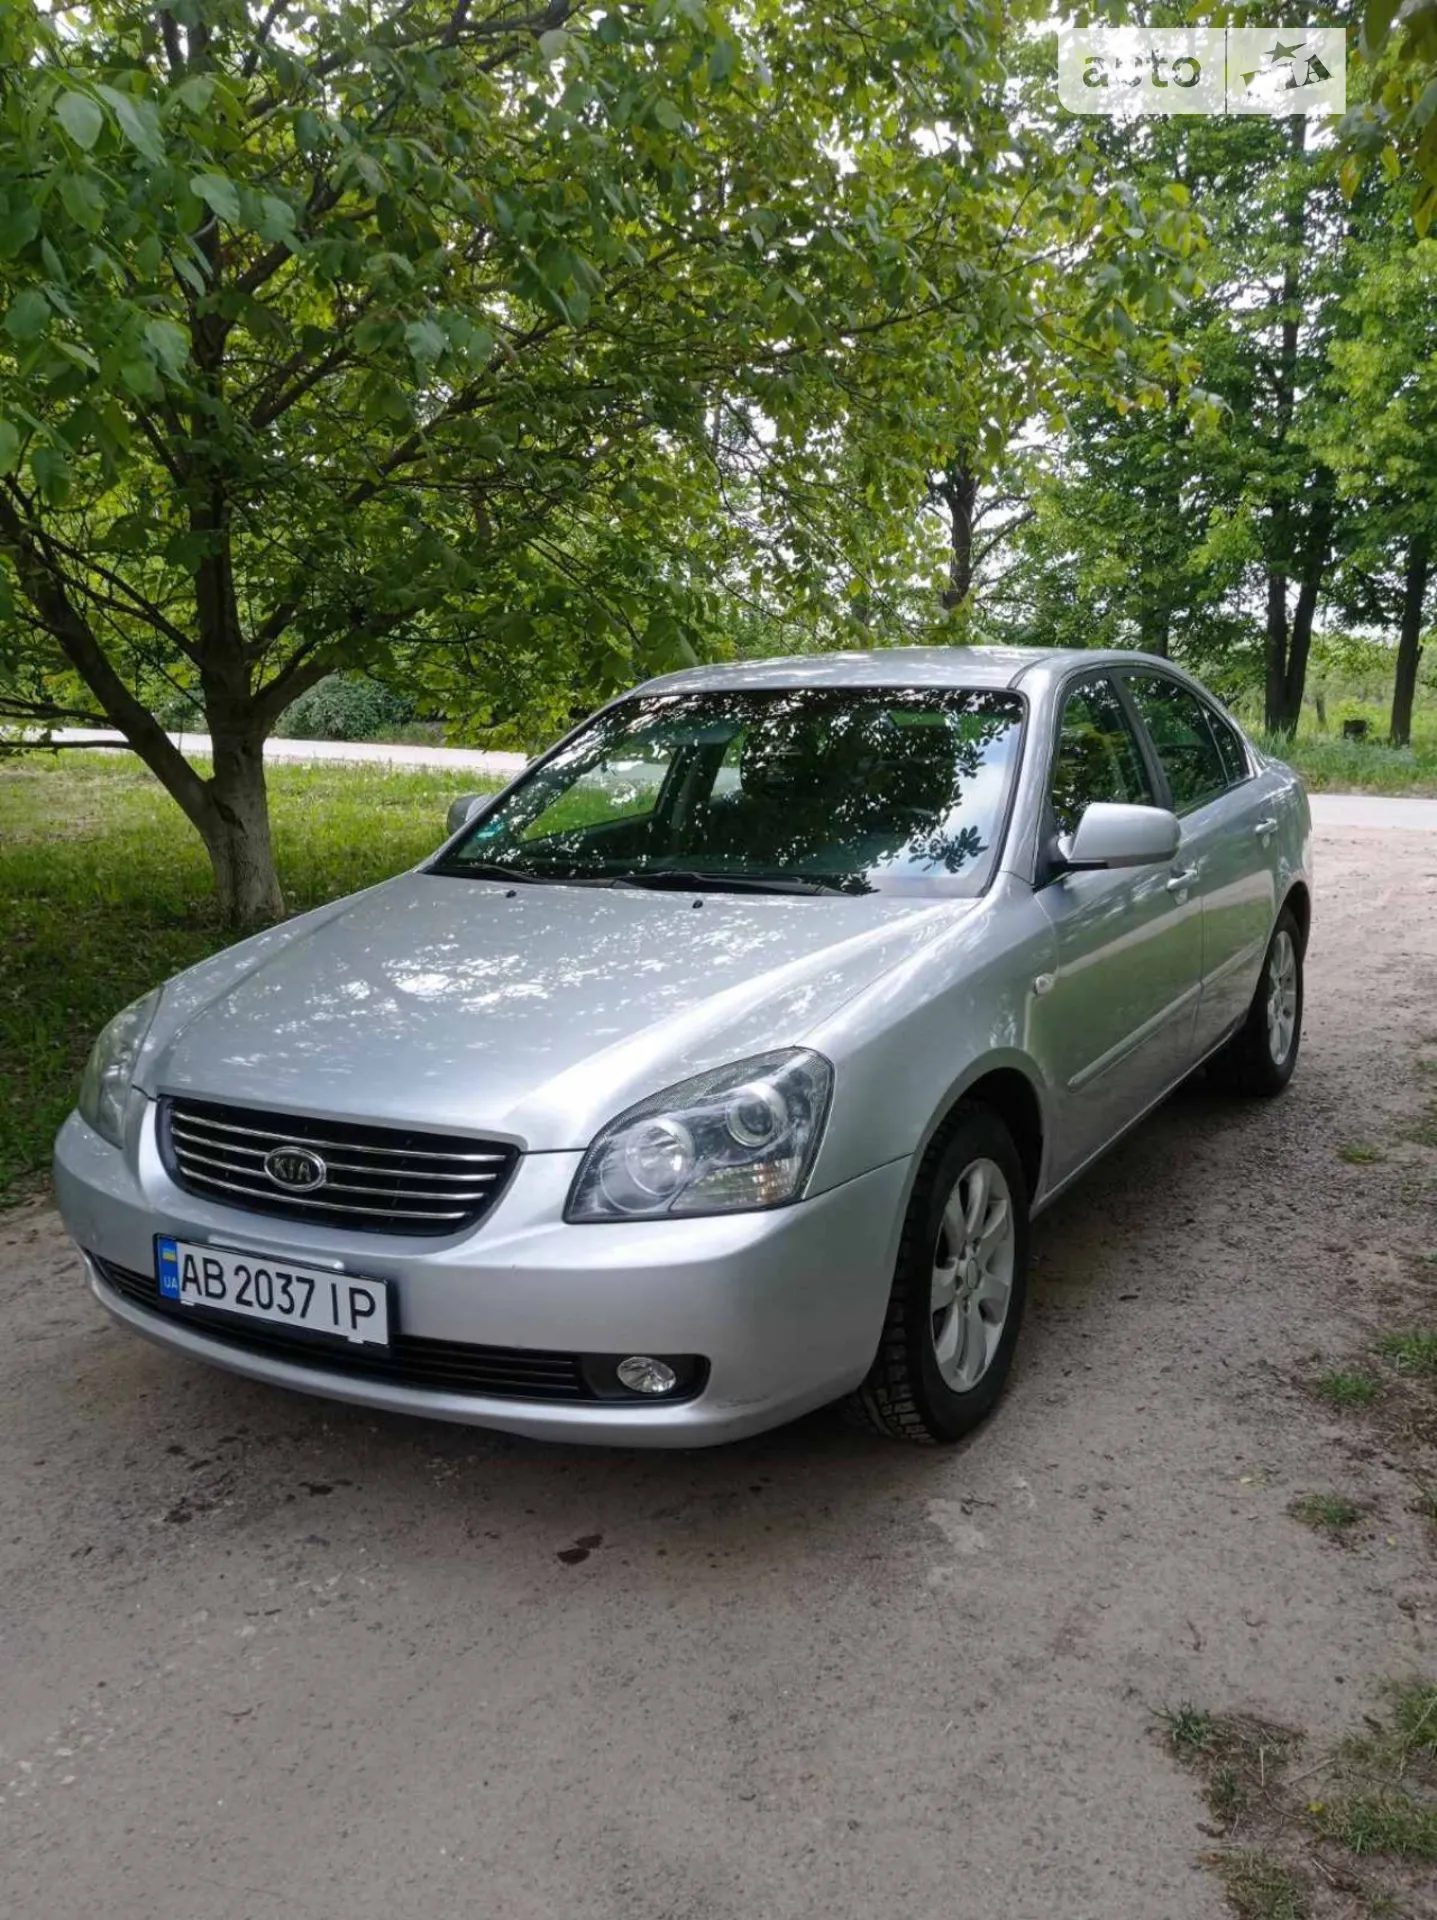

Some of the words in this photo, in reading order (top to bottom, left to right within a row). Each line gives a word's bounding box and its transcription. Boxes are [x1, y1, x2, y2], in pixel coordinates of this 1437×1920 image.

[274, 1158, 311, 1182] KIA
[163, 1275, 178, 1289] UA
[182, 1254, 227, 1299] AB
[234, 1265, 315, 1319] 2037
[331, 1283, 376, 1330] IP
